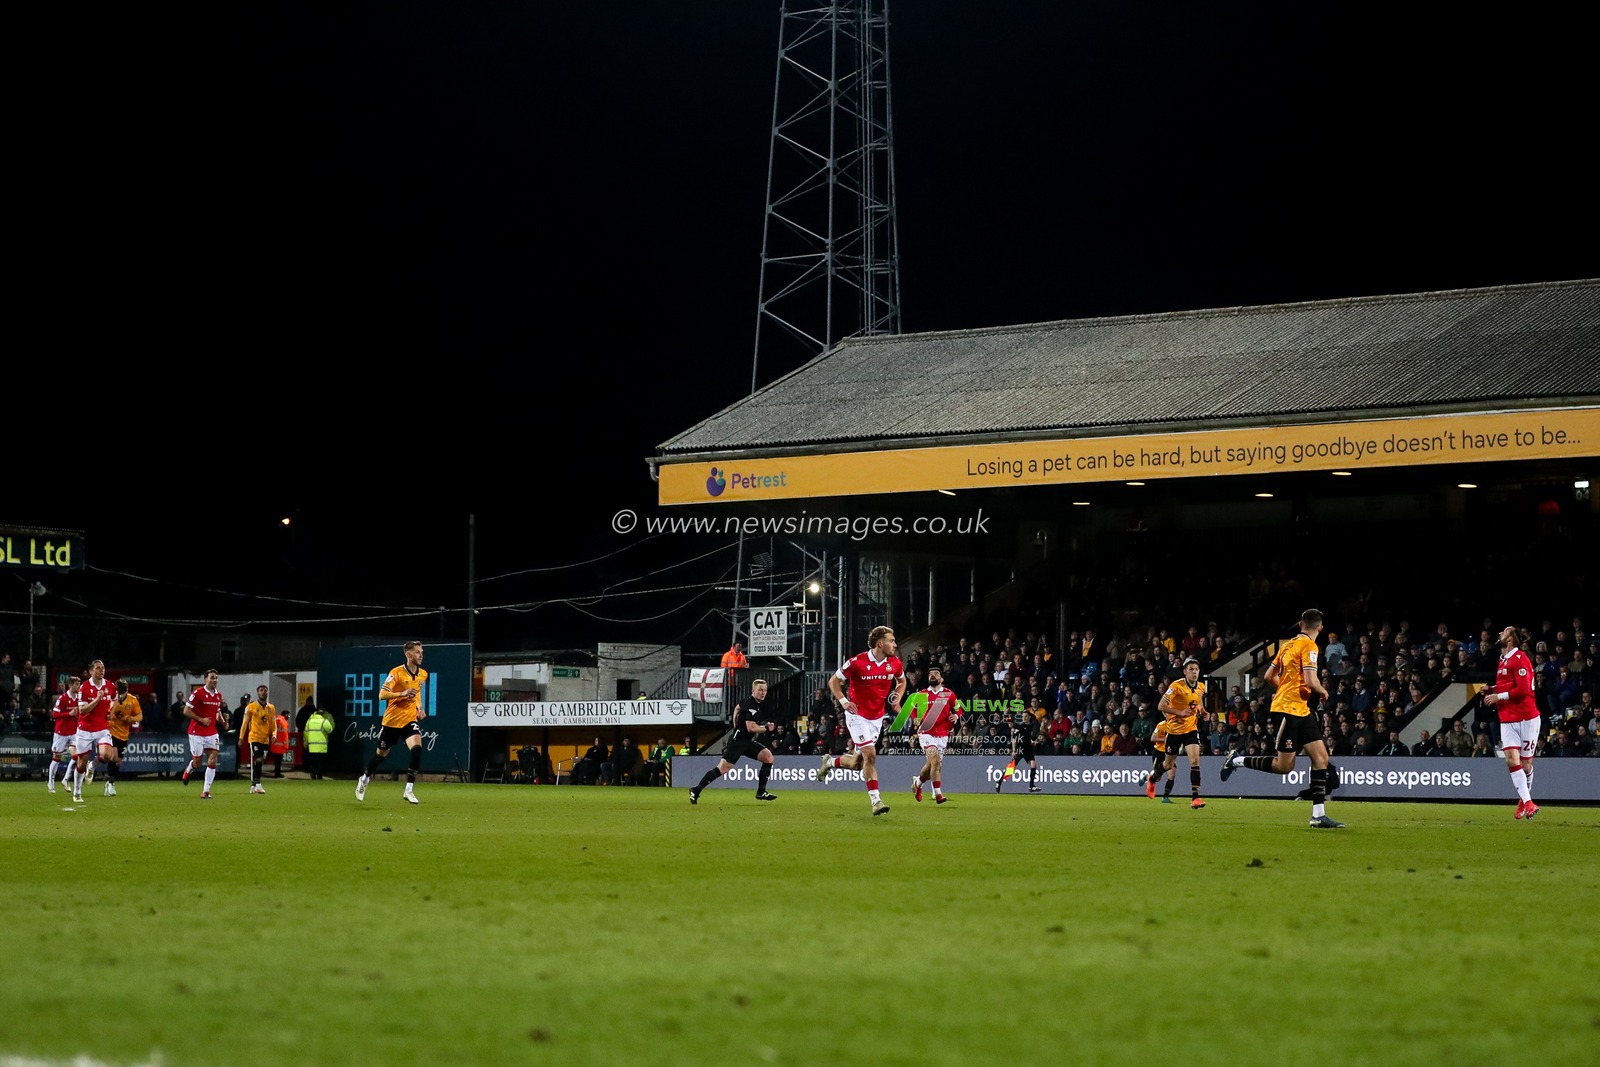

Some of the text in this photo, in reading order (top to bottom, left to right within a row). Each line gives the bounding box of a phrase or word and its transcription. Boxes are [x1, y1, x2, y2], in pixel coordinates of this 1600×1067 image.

[967, 425, 1581, 478] Losing a pet can be hard, but saying goodbye doesn't have to be...
[731, 471, 787, 490] Petrest
[30, 538, 71, 566] Ltd
[753, 611, 783, 629] CAT
[489, 691, 501, 701] 02
[494, 702, 662, 717] GROUP 1 CAMBRIDGE MINI
[532, 717, 560, 725] SEARCH:
[1523, 741, 1535, 751] 26
[158, 755, 185, 763] Solutions
[745, 764, 805, 781] buiness
[1082, 769, 1155, 787] expense
[1308, 766, 1384, 785] iness
[1387, 770, 1471, 789] expenses
